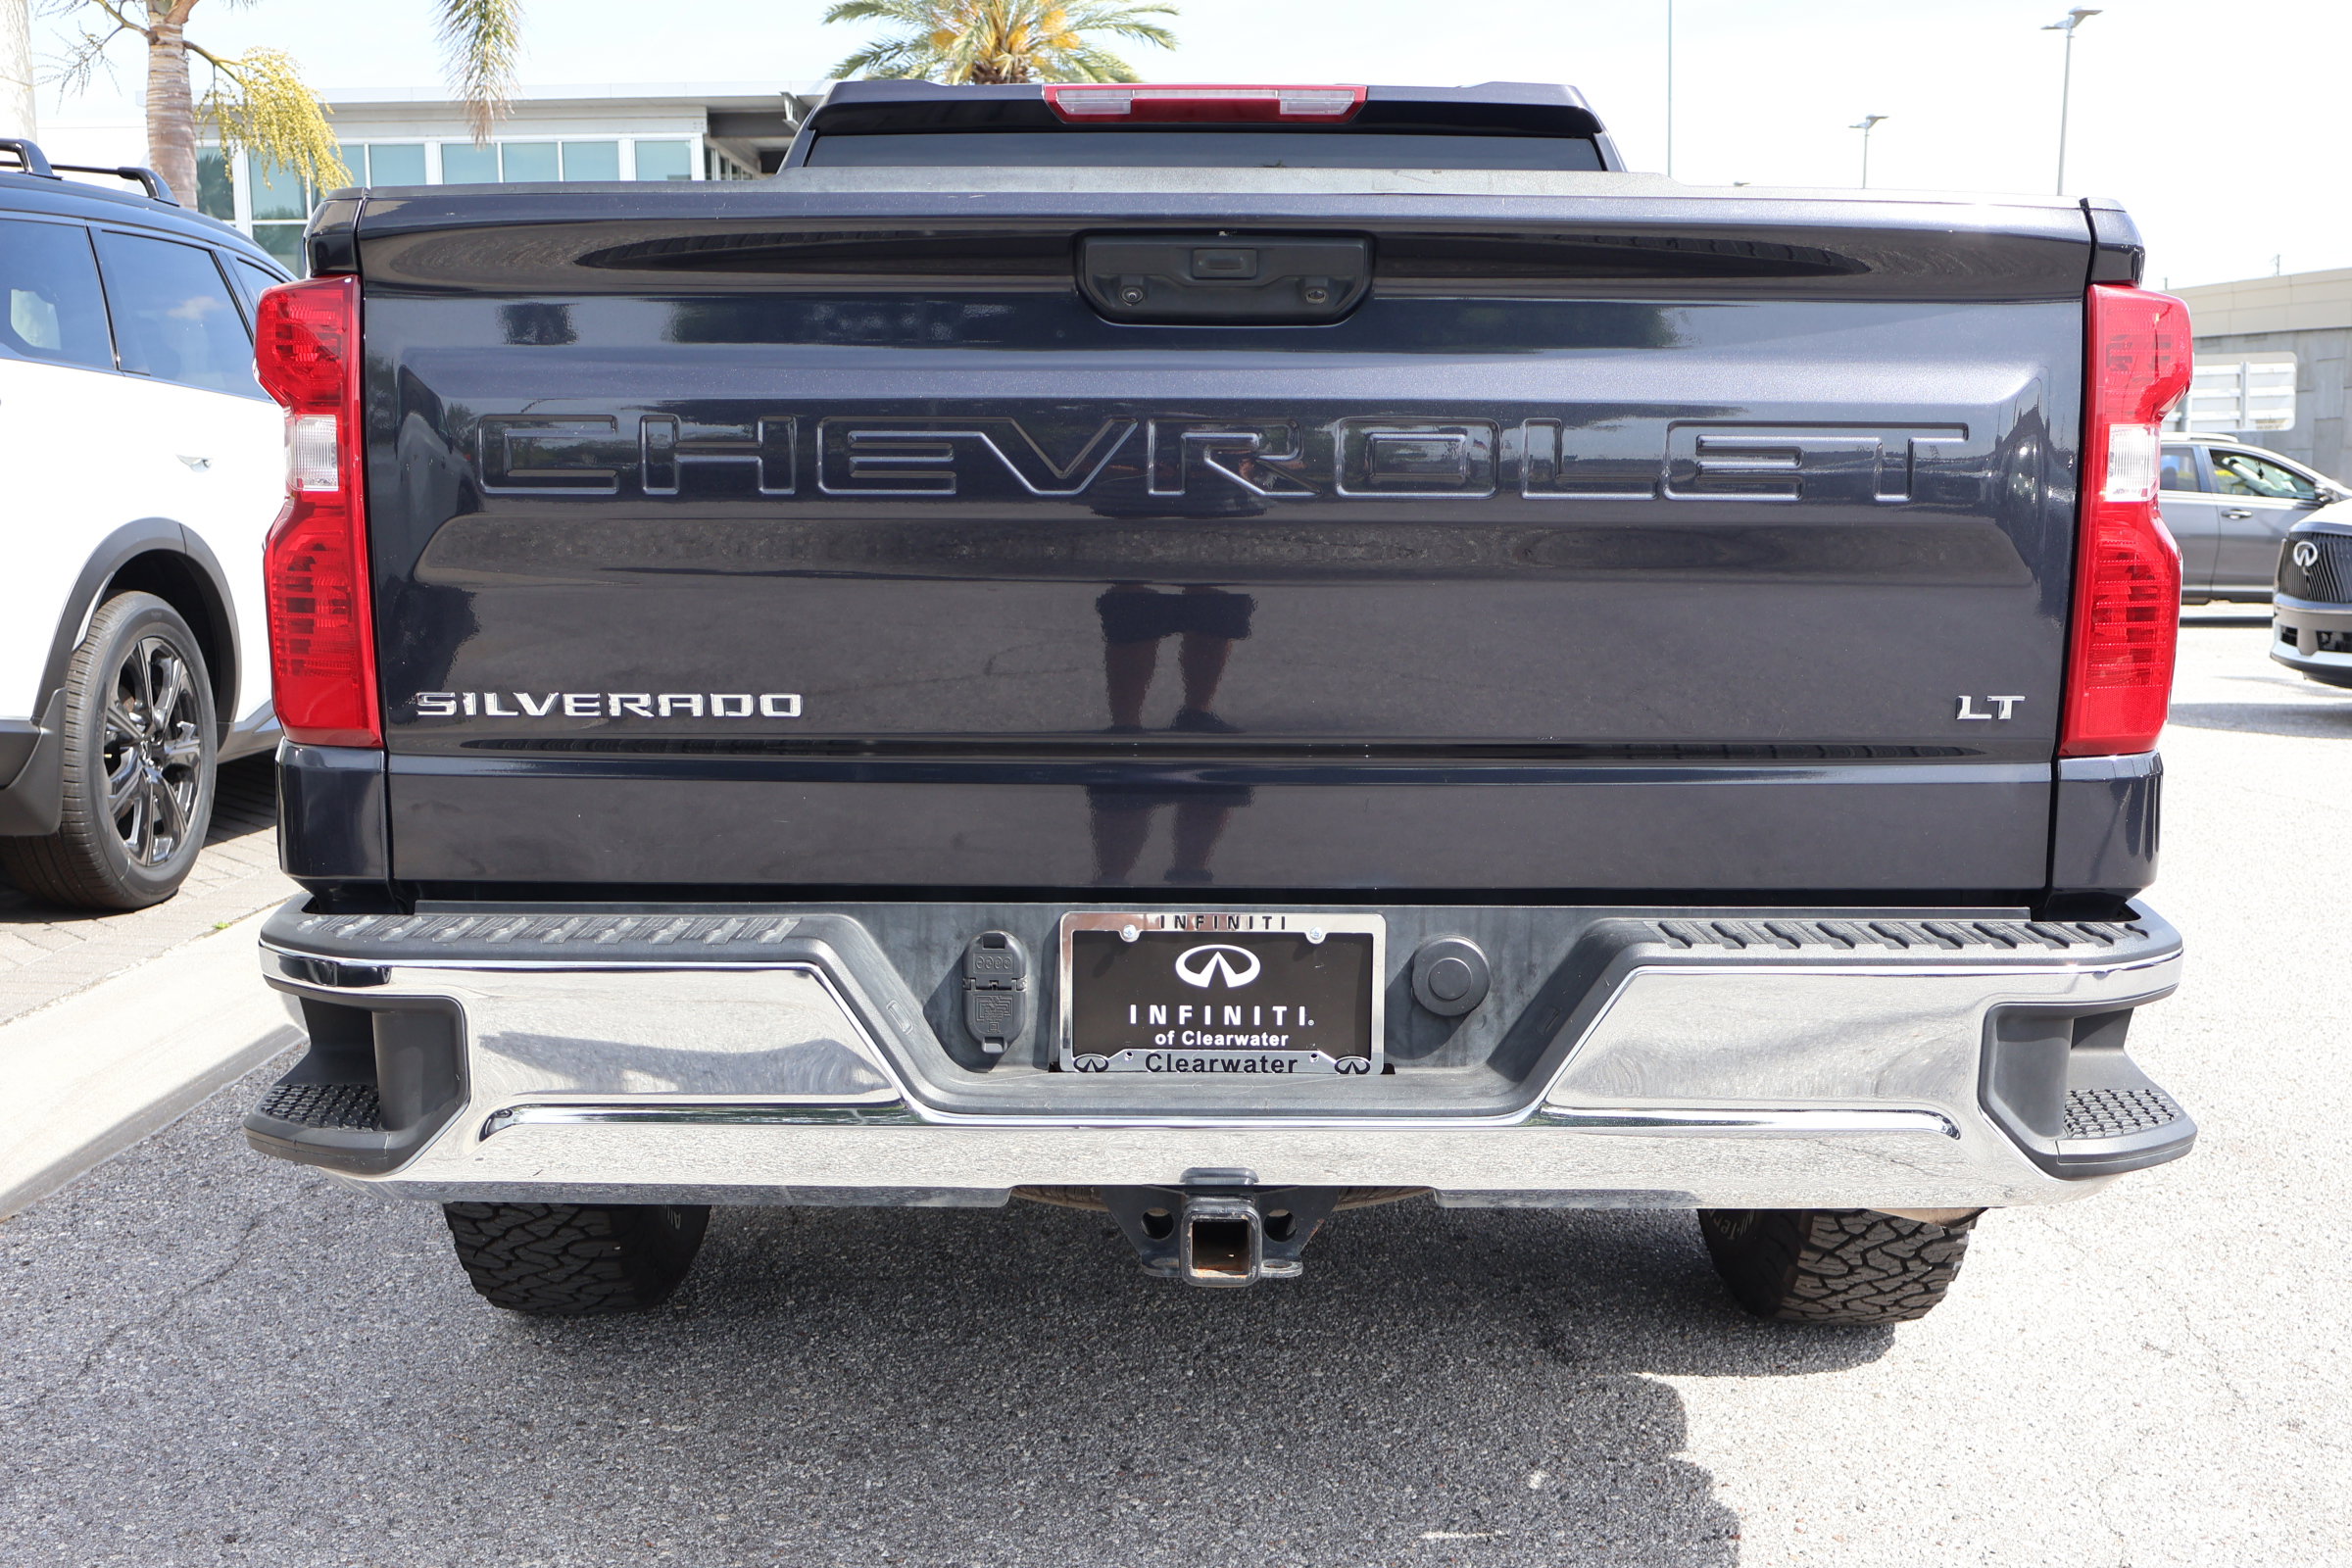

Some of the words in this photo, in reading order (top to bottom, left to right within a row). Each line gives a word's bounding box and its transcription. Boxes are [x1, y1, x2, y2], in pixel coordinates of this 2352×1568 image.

[477, 413, 1968, 501] CHEVROLET
[416, 692, 804, 717] SILVERADO
[1956, 695, 2026, 719] LT
[1160, 914, 1286, 930] INFINITI
[1154, 1030, 1175, 1046] of
[1181, 1030, 1289, 1047] Clearwater
[1145, 1054, 1298, 1073] Clearwater
